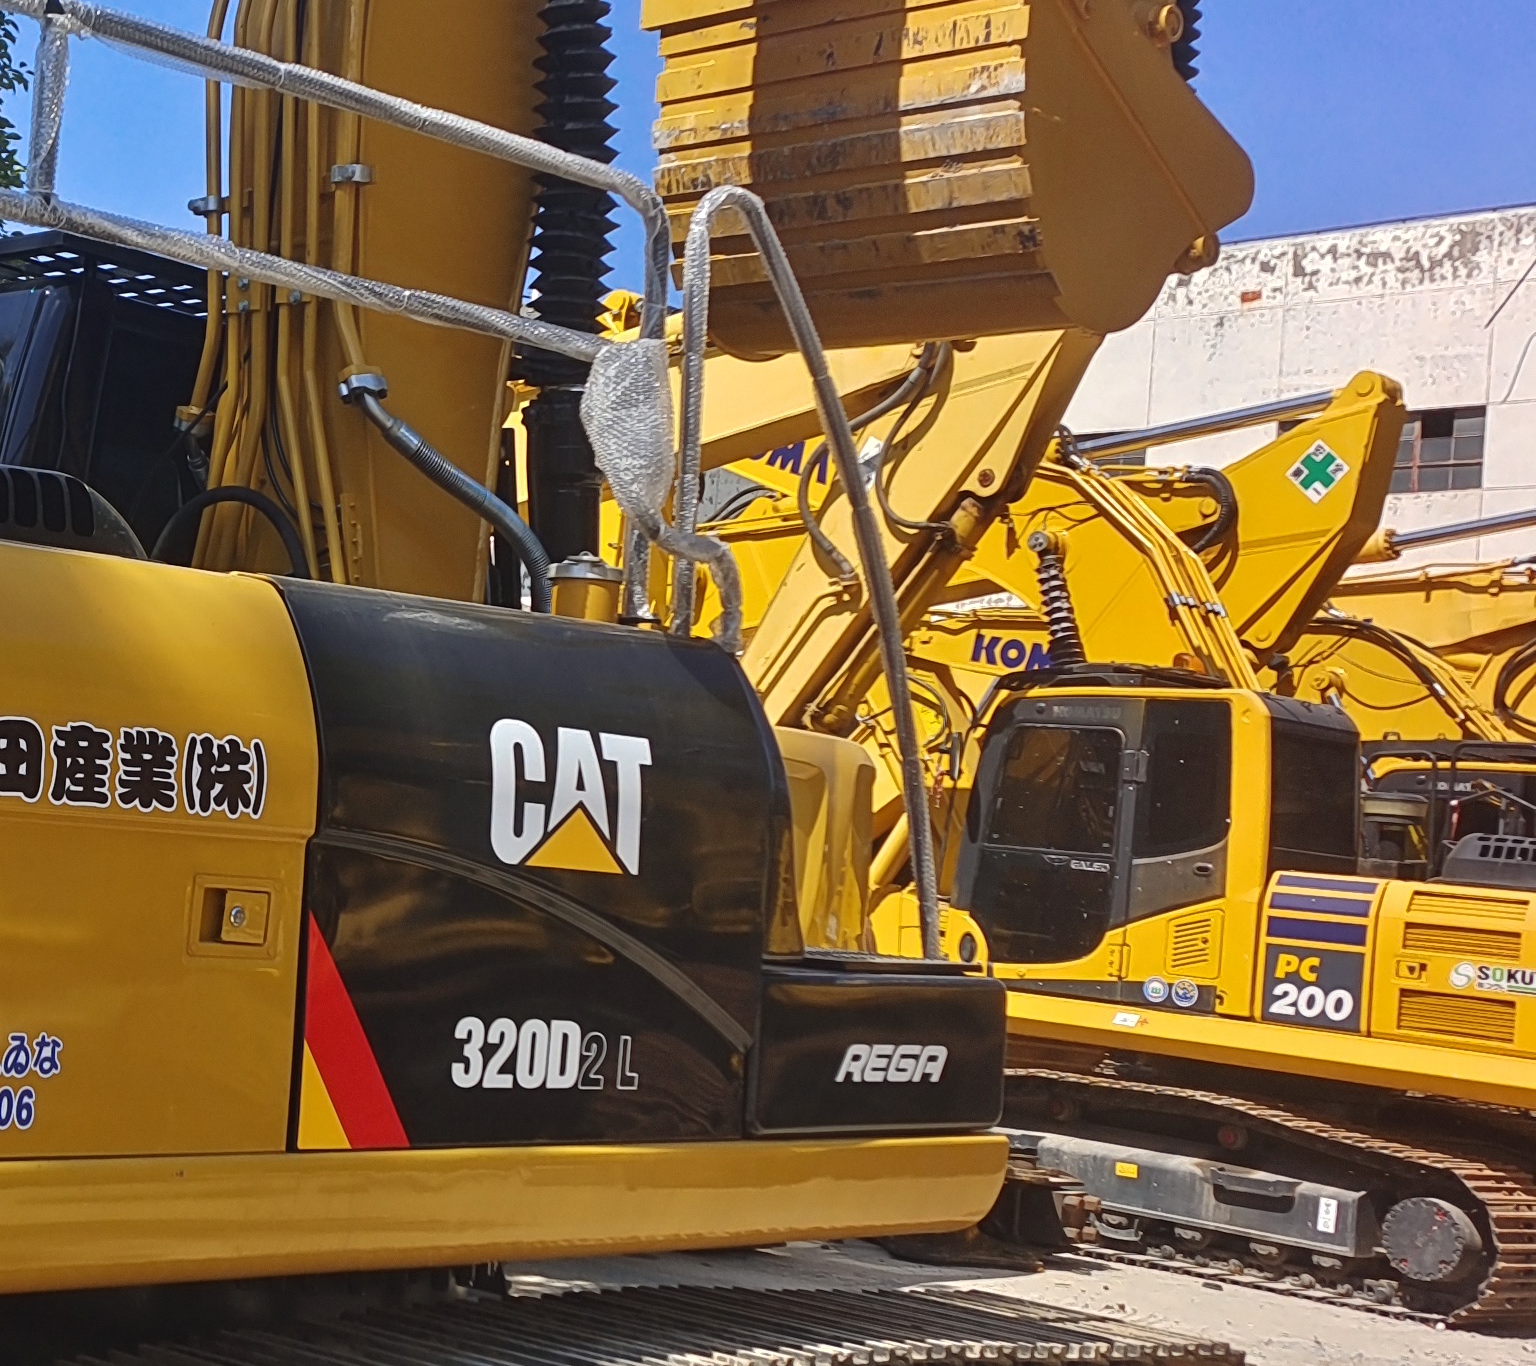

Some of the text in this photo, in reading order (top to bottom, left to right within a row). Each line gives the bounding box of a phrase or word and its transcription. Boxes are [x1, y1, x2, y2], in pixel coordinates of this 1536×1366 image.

[489, 718, 652, 876] CAT
[1273, 953, 1321, 982] PC
[1476, 965, 1536, 985] SOKU
[1268, 982, 1354, 1022] 200
[835, 1043, 949, 1083] REGA
